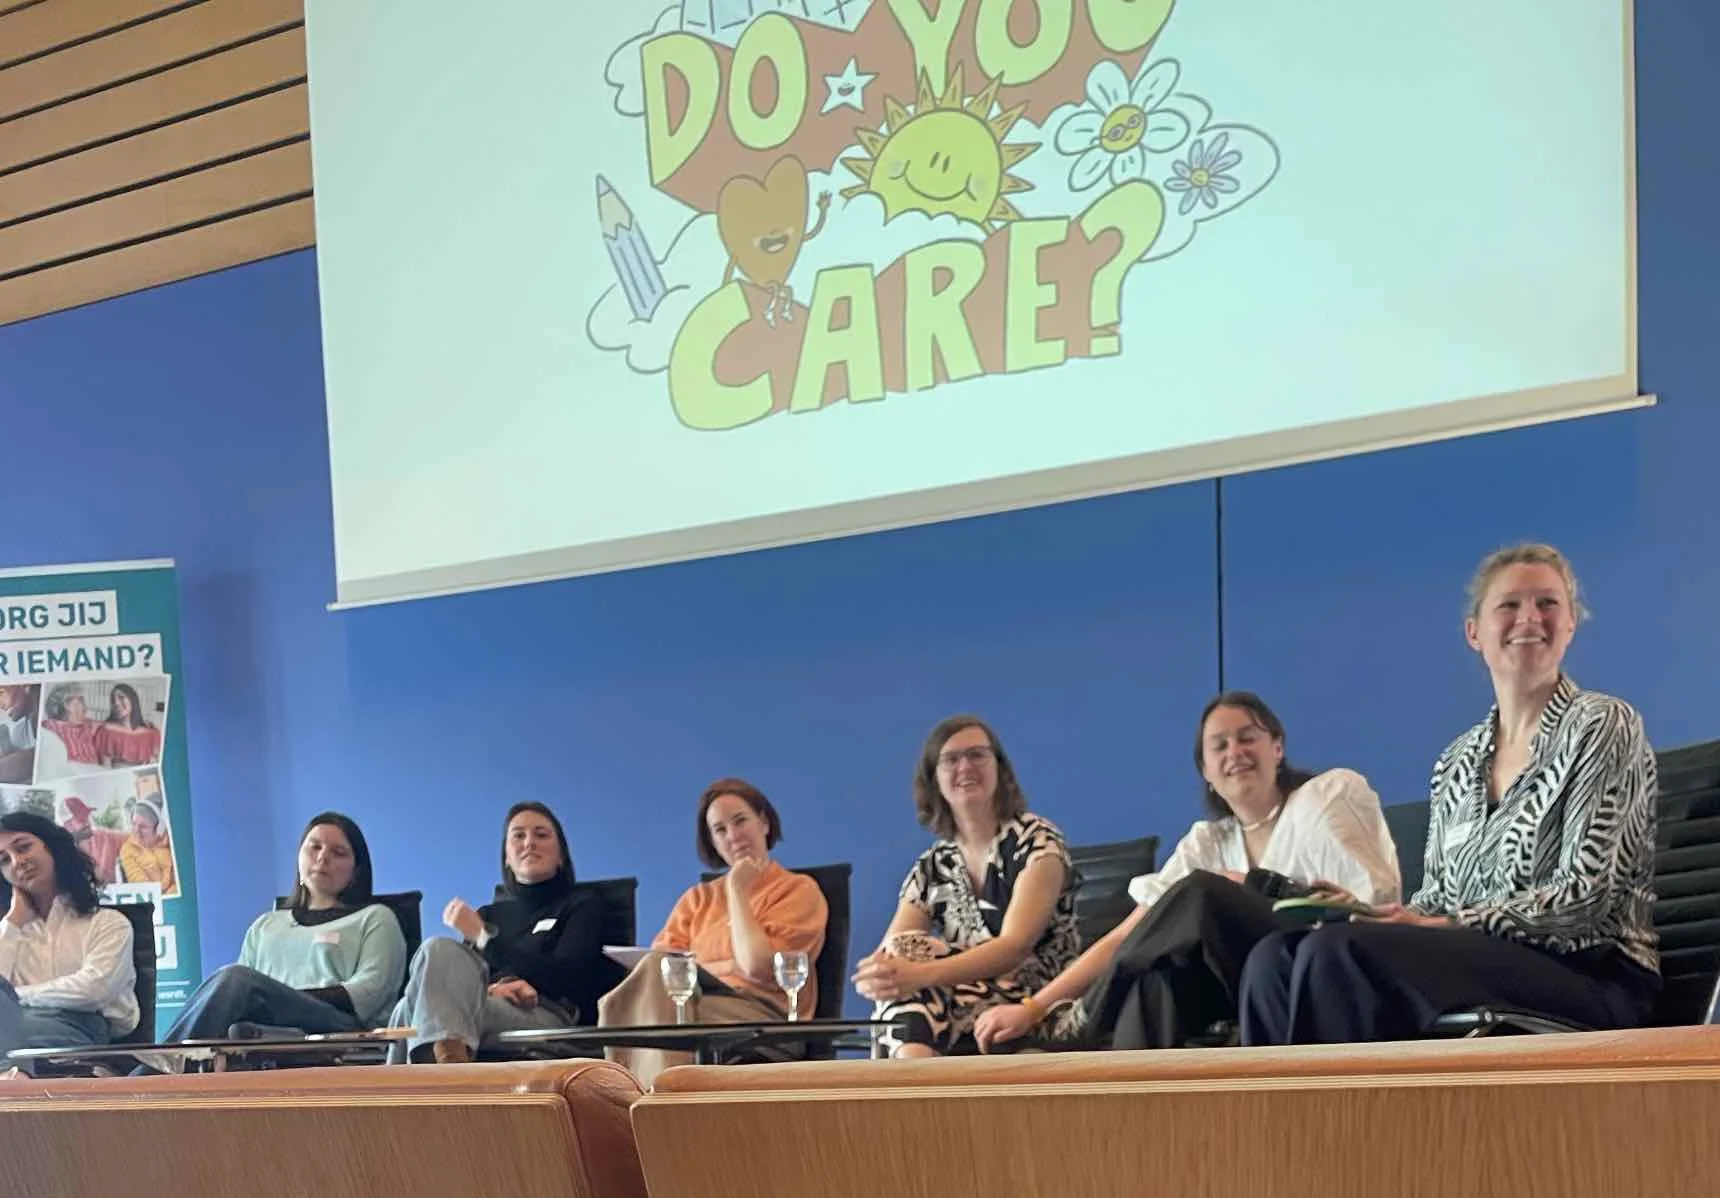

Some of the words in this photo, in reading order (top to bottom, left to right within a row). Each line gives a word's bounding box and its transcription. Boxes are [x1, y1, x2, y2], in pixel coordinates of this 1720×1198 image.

[641, 11, 808, 188] DO
[668, 179, 1165, 431] CARE?
[17, 643, 154, 675] IEMAND?
[58, 601, 107, 627] JIJ
